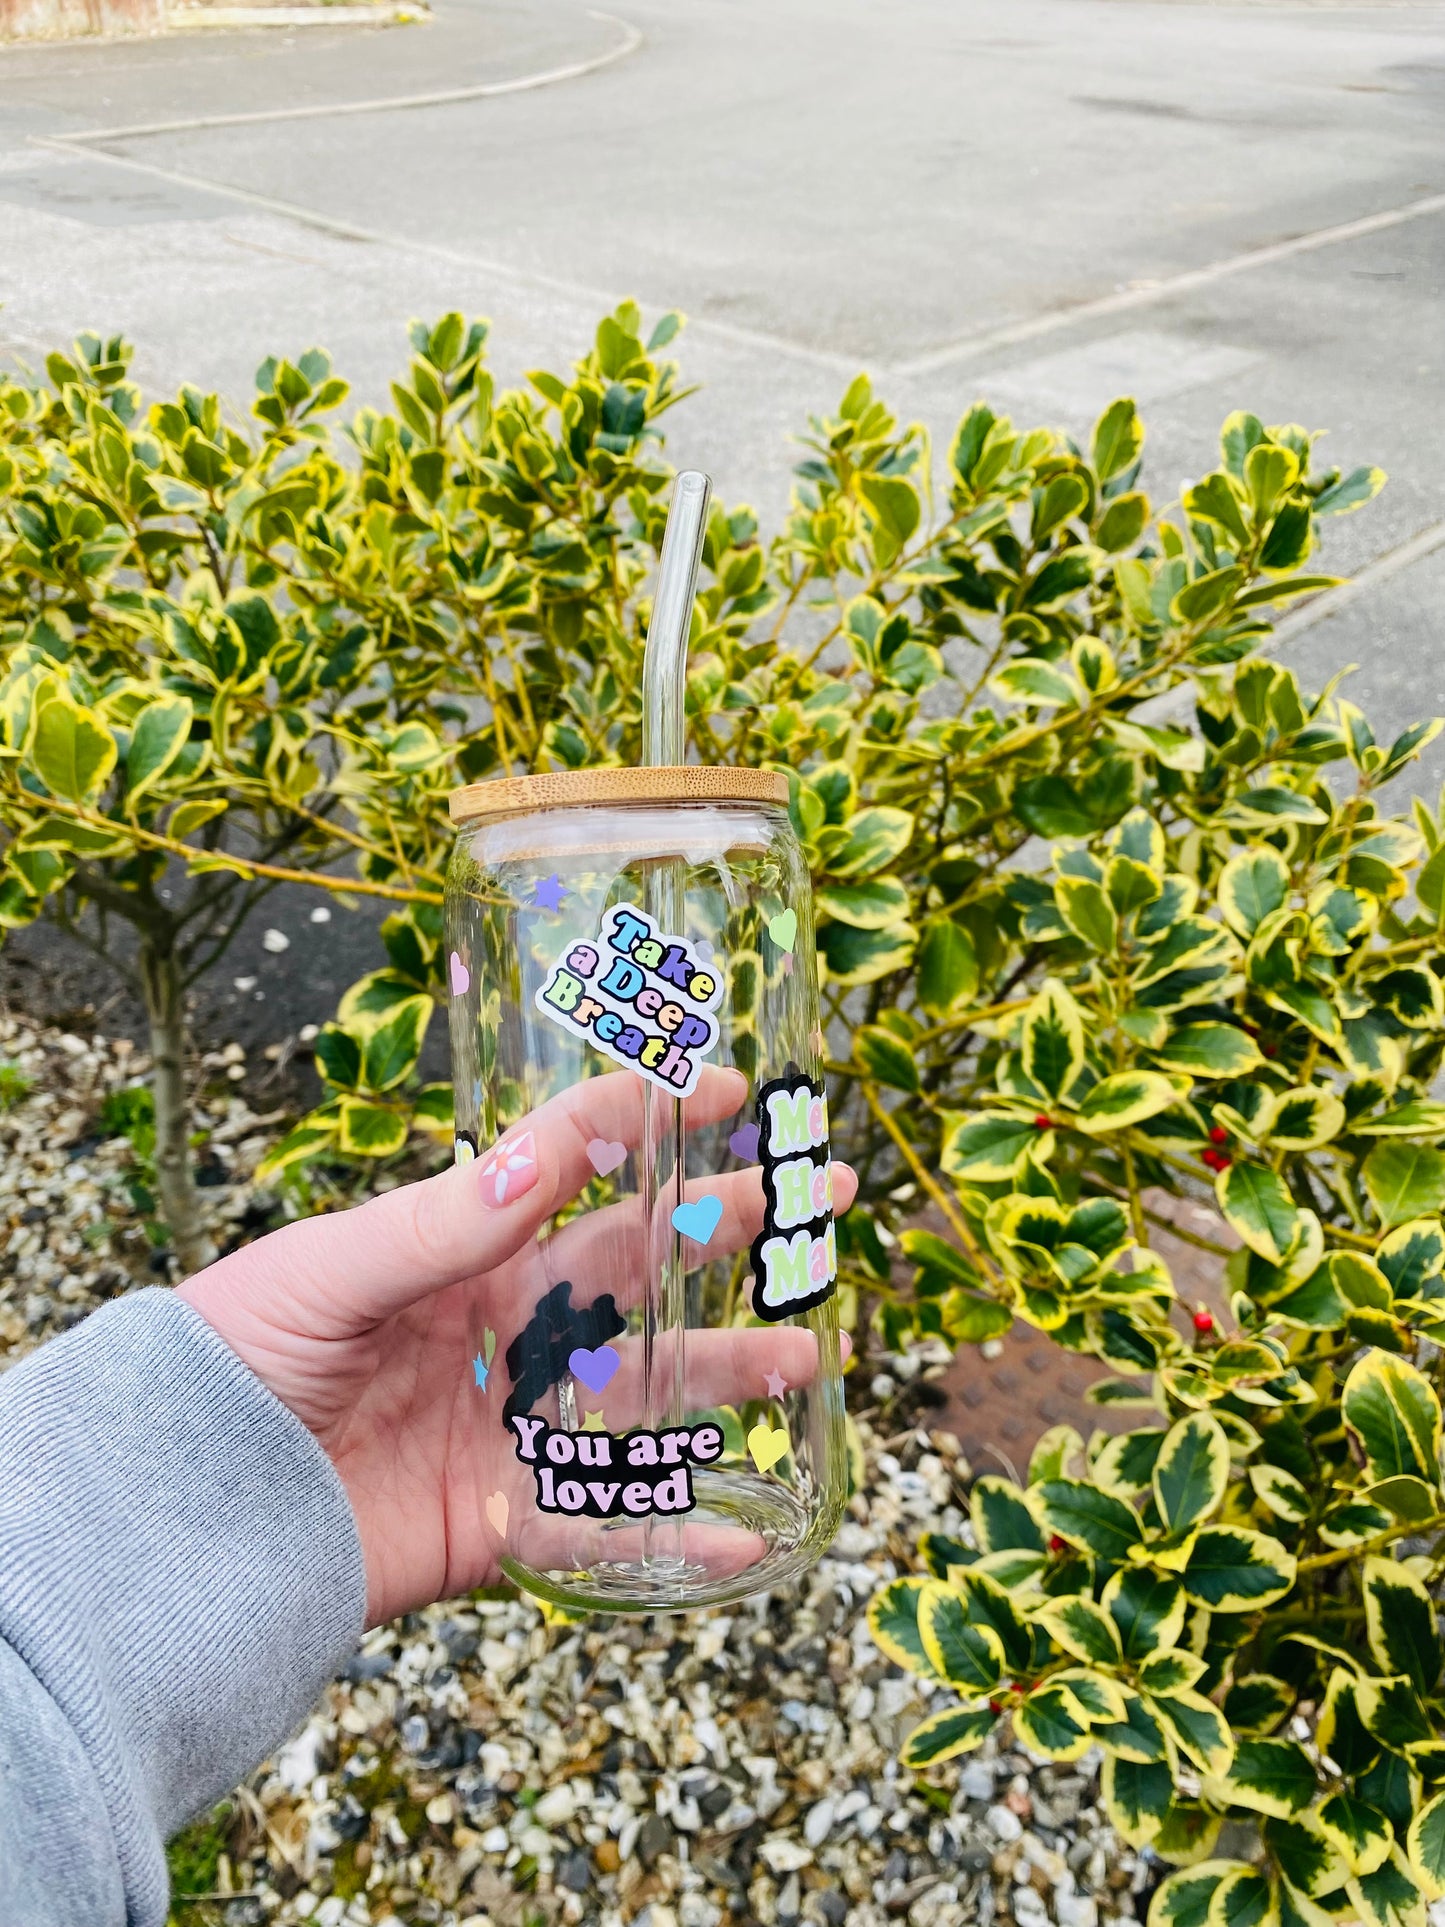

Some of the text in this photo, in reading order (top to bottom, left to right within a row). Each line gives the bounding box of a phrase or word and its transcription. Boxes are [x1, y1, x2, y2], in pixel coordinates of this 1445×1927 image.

[566, 945, 711, 1049] a Deep
[608, 910, 716, 1003] Take
[543, 968, 693, 1089] Breath
[511, 1415, 721, 1467] You are
[538, 1467, 692, 1513] loved
